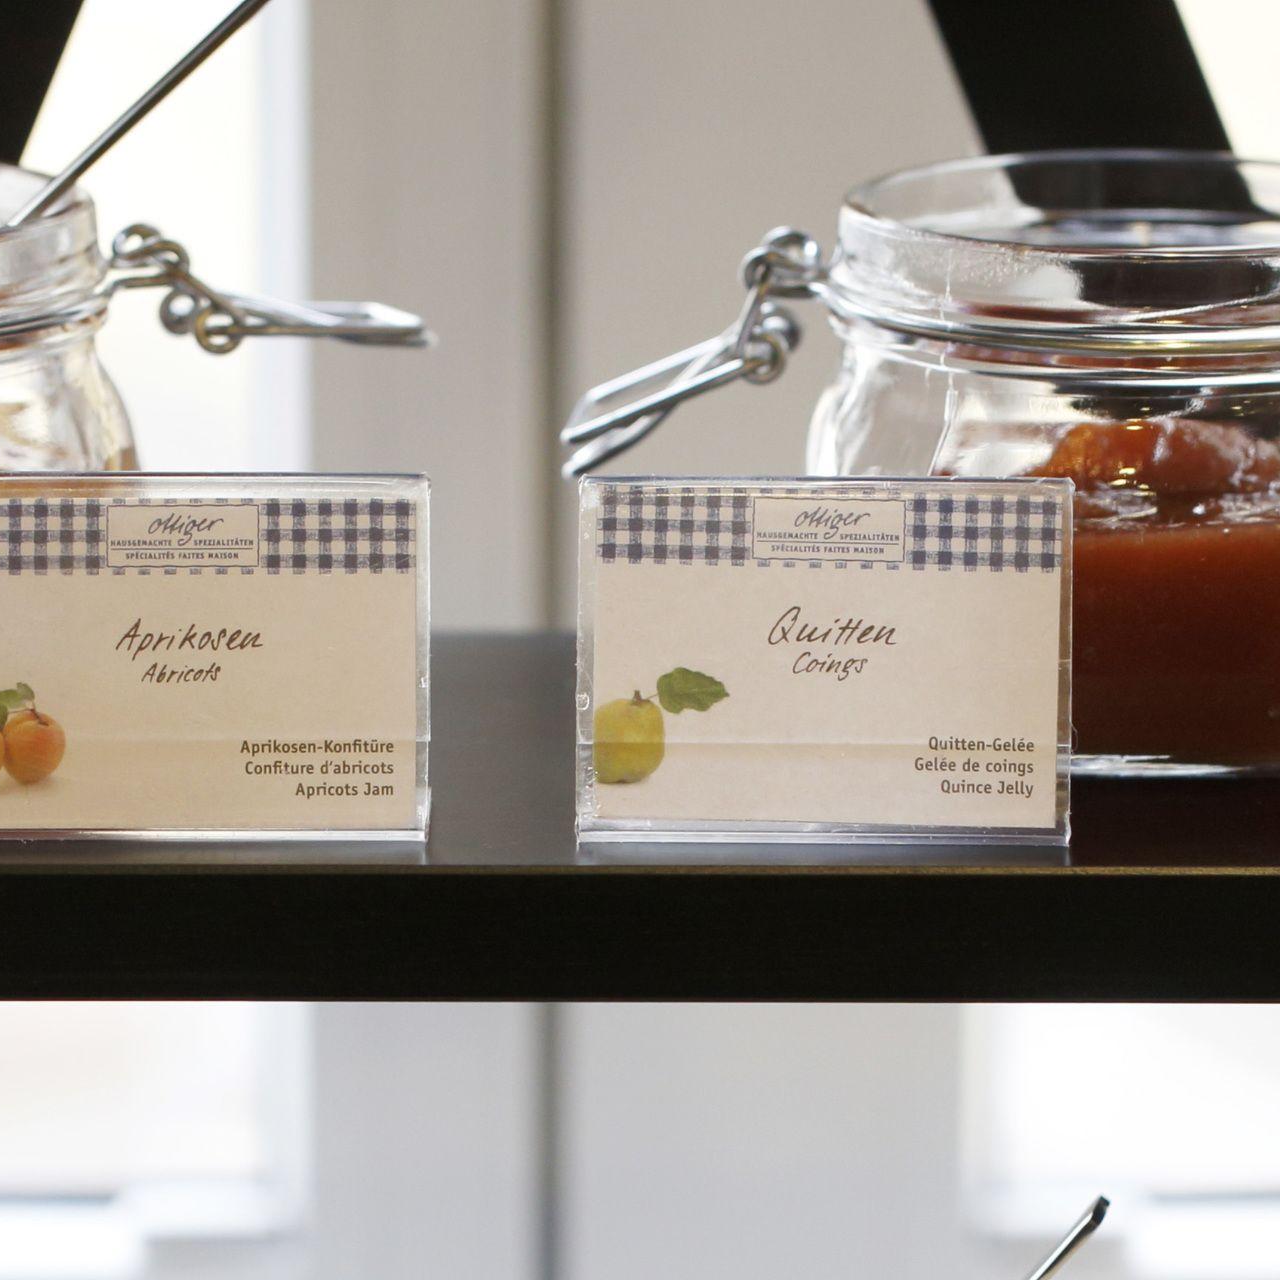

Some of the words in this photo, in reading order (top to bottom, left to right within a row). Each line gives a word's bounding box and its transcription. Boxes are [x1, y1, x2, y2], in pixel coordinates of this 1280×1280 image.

[110, 538, 172, 547] HAUSGEMACHTE
[193, 537, 254, 547] SPEZIALITÄTEN
[757, 531, 819, 541] HAUSGEMACHTE
[839, 532, 900, 542] SPEZIALITÄTEN
[768, 606, 896, 645] Quitten
[116, 618, 263, 661] Aprikosen
[141, 662, 221, 683] Abricots
[793, 652, 868, 681] Coings
[240, 739, 393, 757] Aprikosen-Konfitüre
[929, 737, 1034, 752] Quitten-Gelée
[245, 761, 314, 774] Confiture
[320, 760, 393, 774] d'abricots
[915, 757, 956, 771] Gelée
[963, 758, 980, 772] de
[986, 759, 1033, 776] coings
[296, 782, 358, 799] Apricots
[364, 783, 393, 795] Jam
[941, 780, 992, 794] Quince
[997, 781, 1033, 798] Jelly
